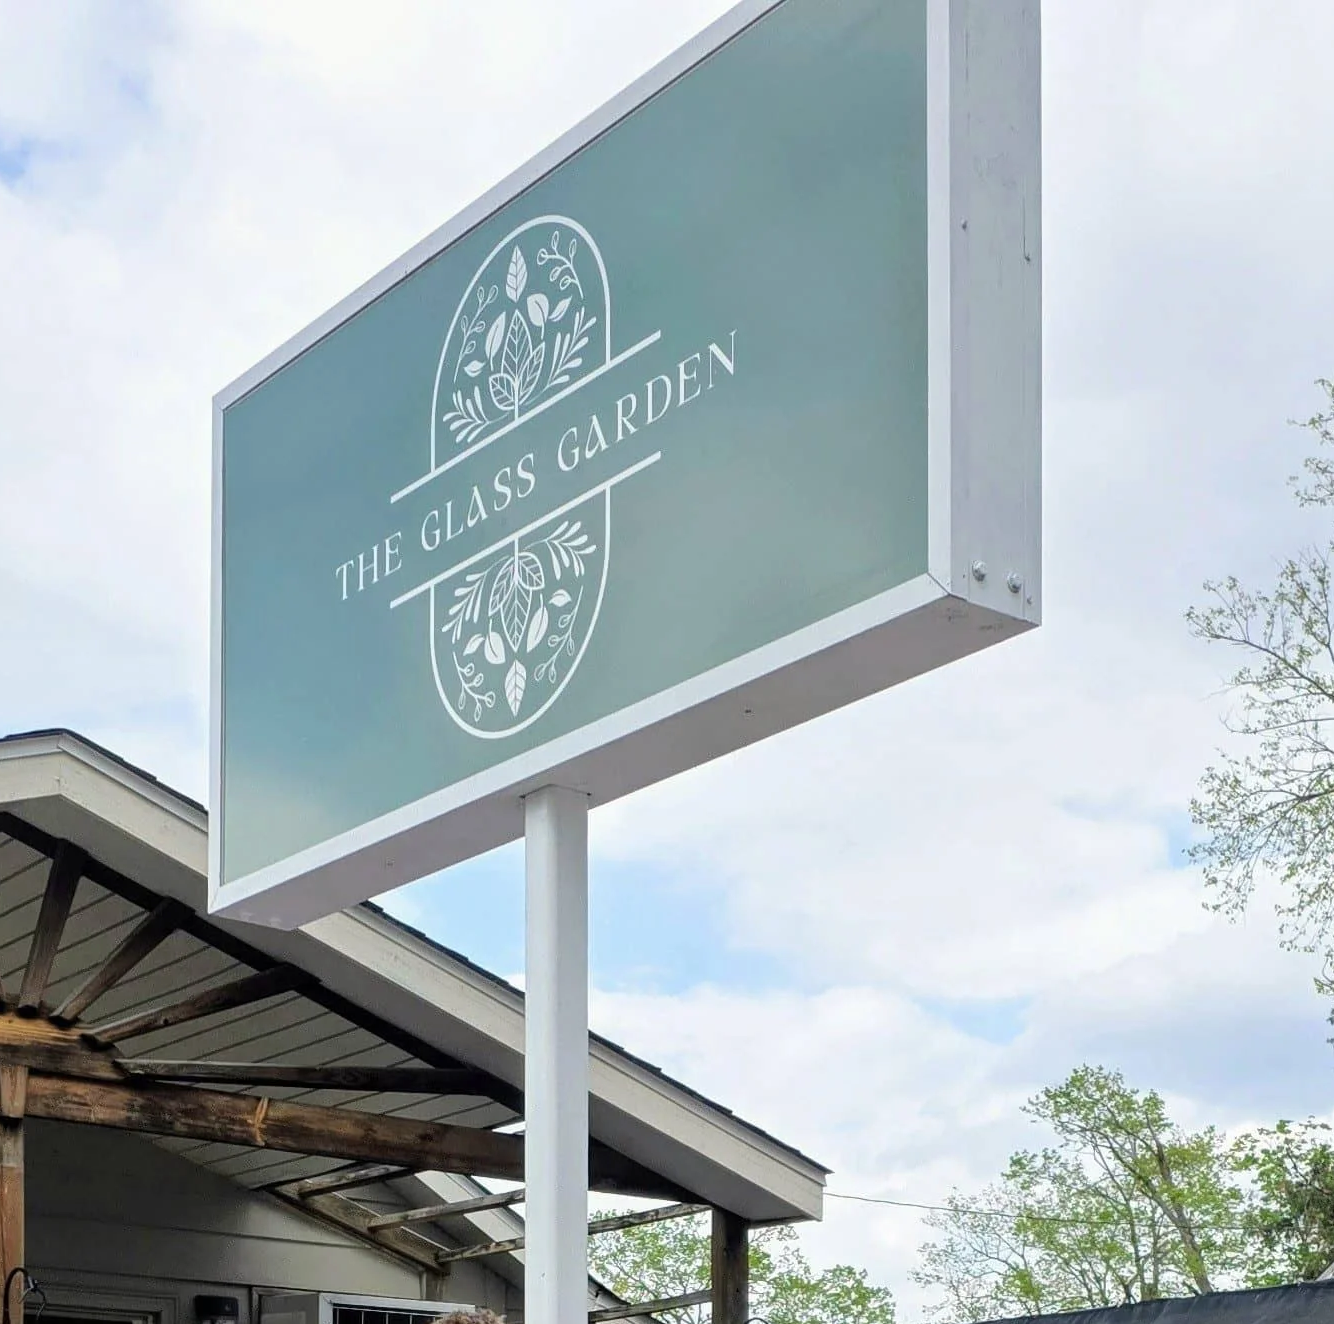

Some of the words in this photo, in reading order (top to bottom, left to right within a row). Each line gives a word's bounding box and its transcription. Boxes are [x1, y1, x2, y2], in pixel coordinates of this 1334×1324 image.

[335, 531, 402, 600] THE
[421, 453, 536, 551] GLASS
[557, 328, 737, 471] GARDEN
